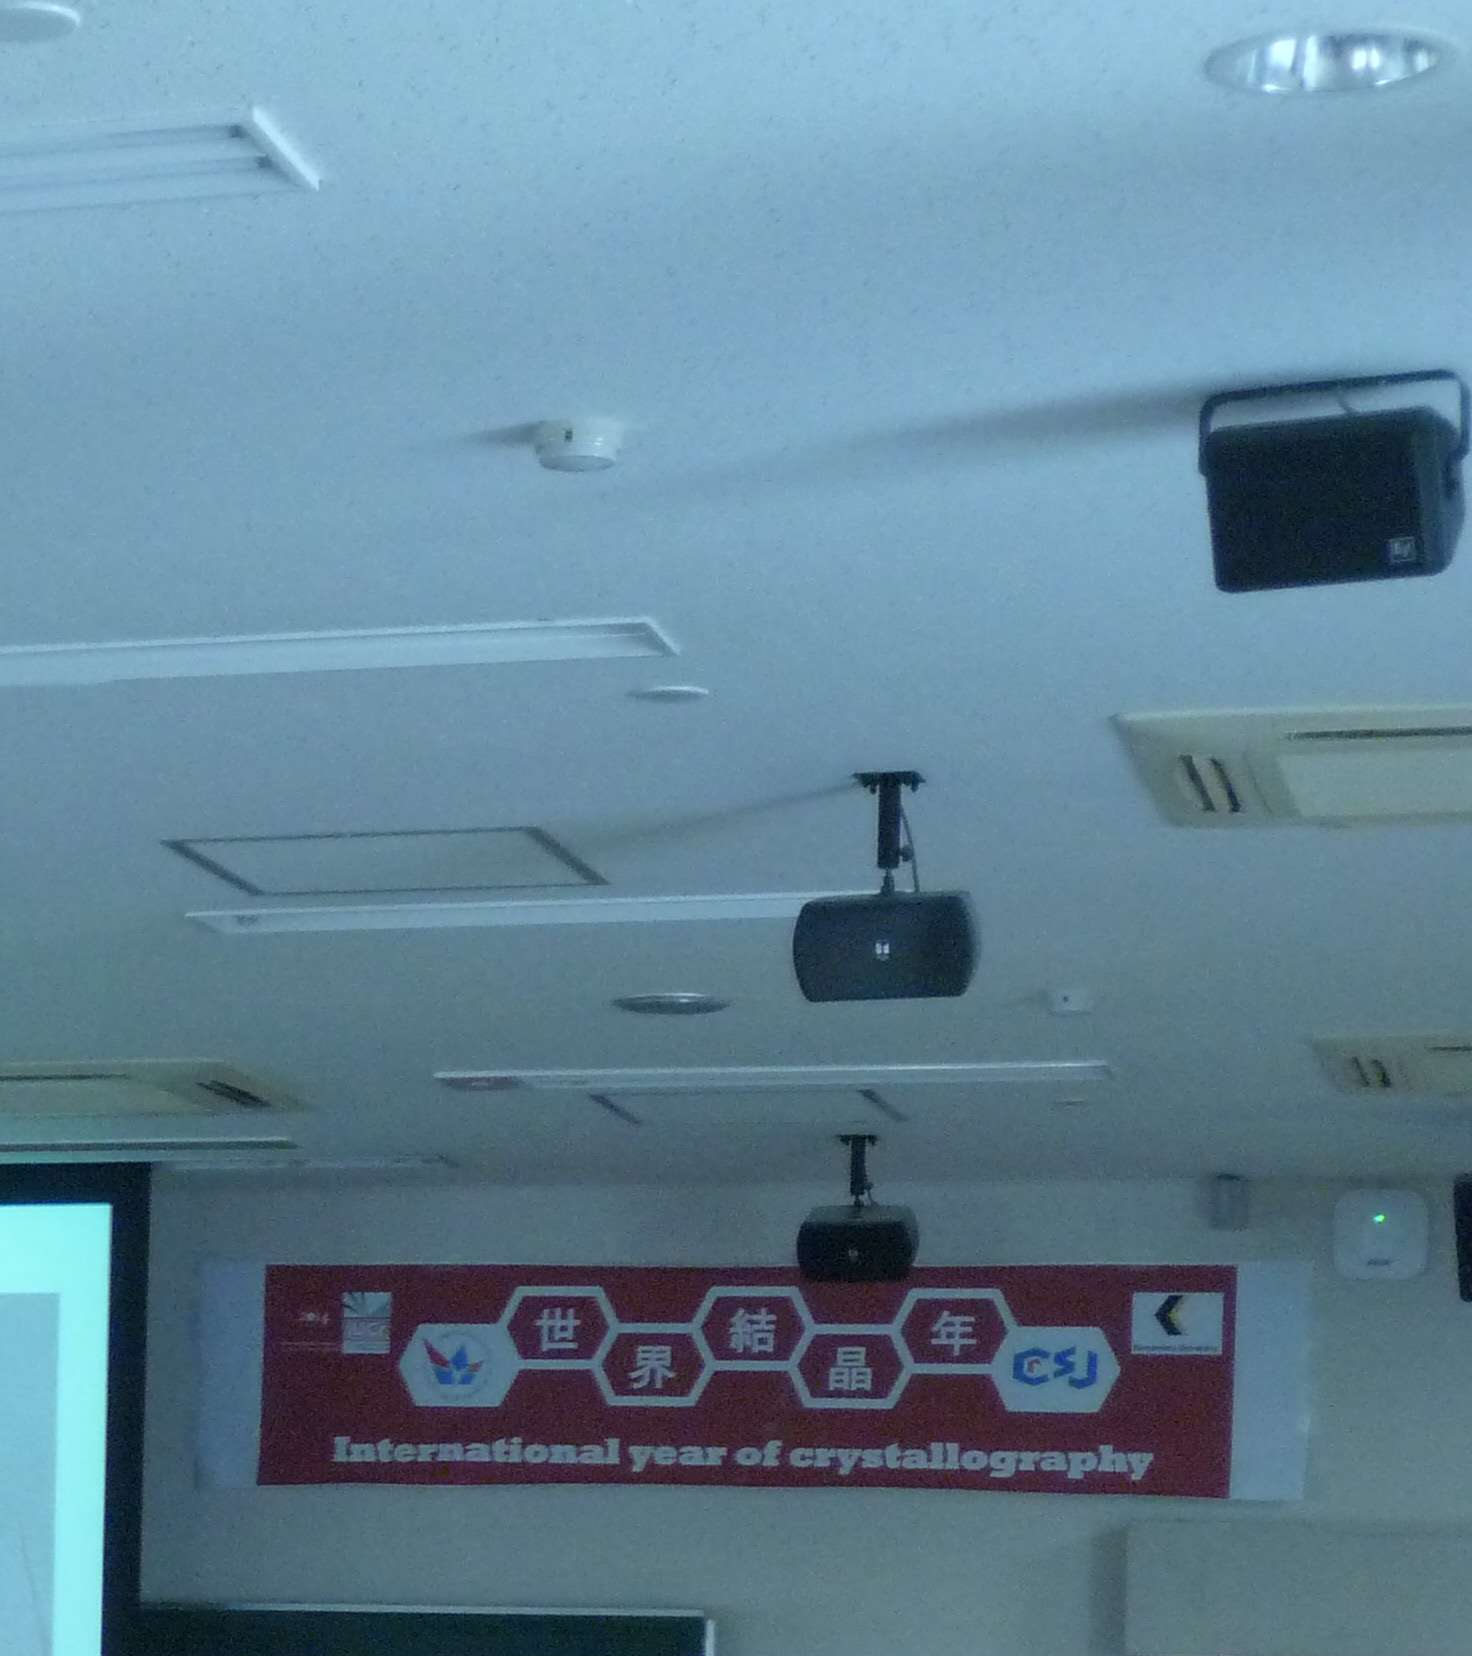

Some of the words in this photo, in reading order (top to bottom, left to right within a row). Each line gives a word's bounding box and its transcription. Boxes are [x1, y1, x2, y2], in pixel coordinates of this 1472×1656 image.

[1012, 1346, 1099, 1390] CSJ
[333, 1435, 621, 1465] International
[628, 1443, 729, 1473] year
[734, 1440, 783, 1467] of
[789, 1441, 1155, 1481] crystallography
